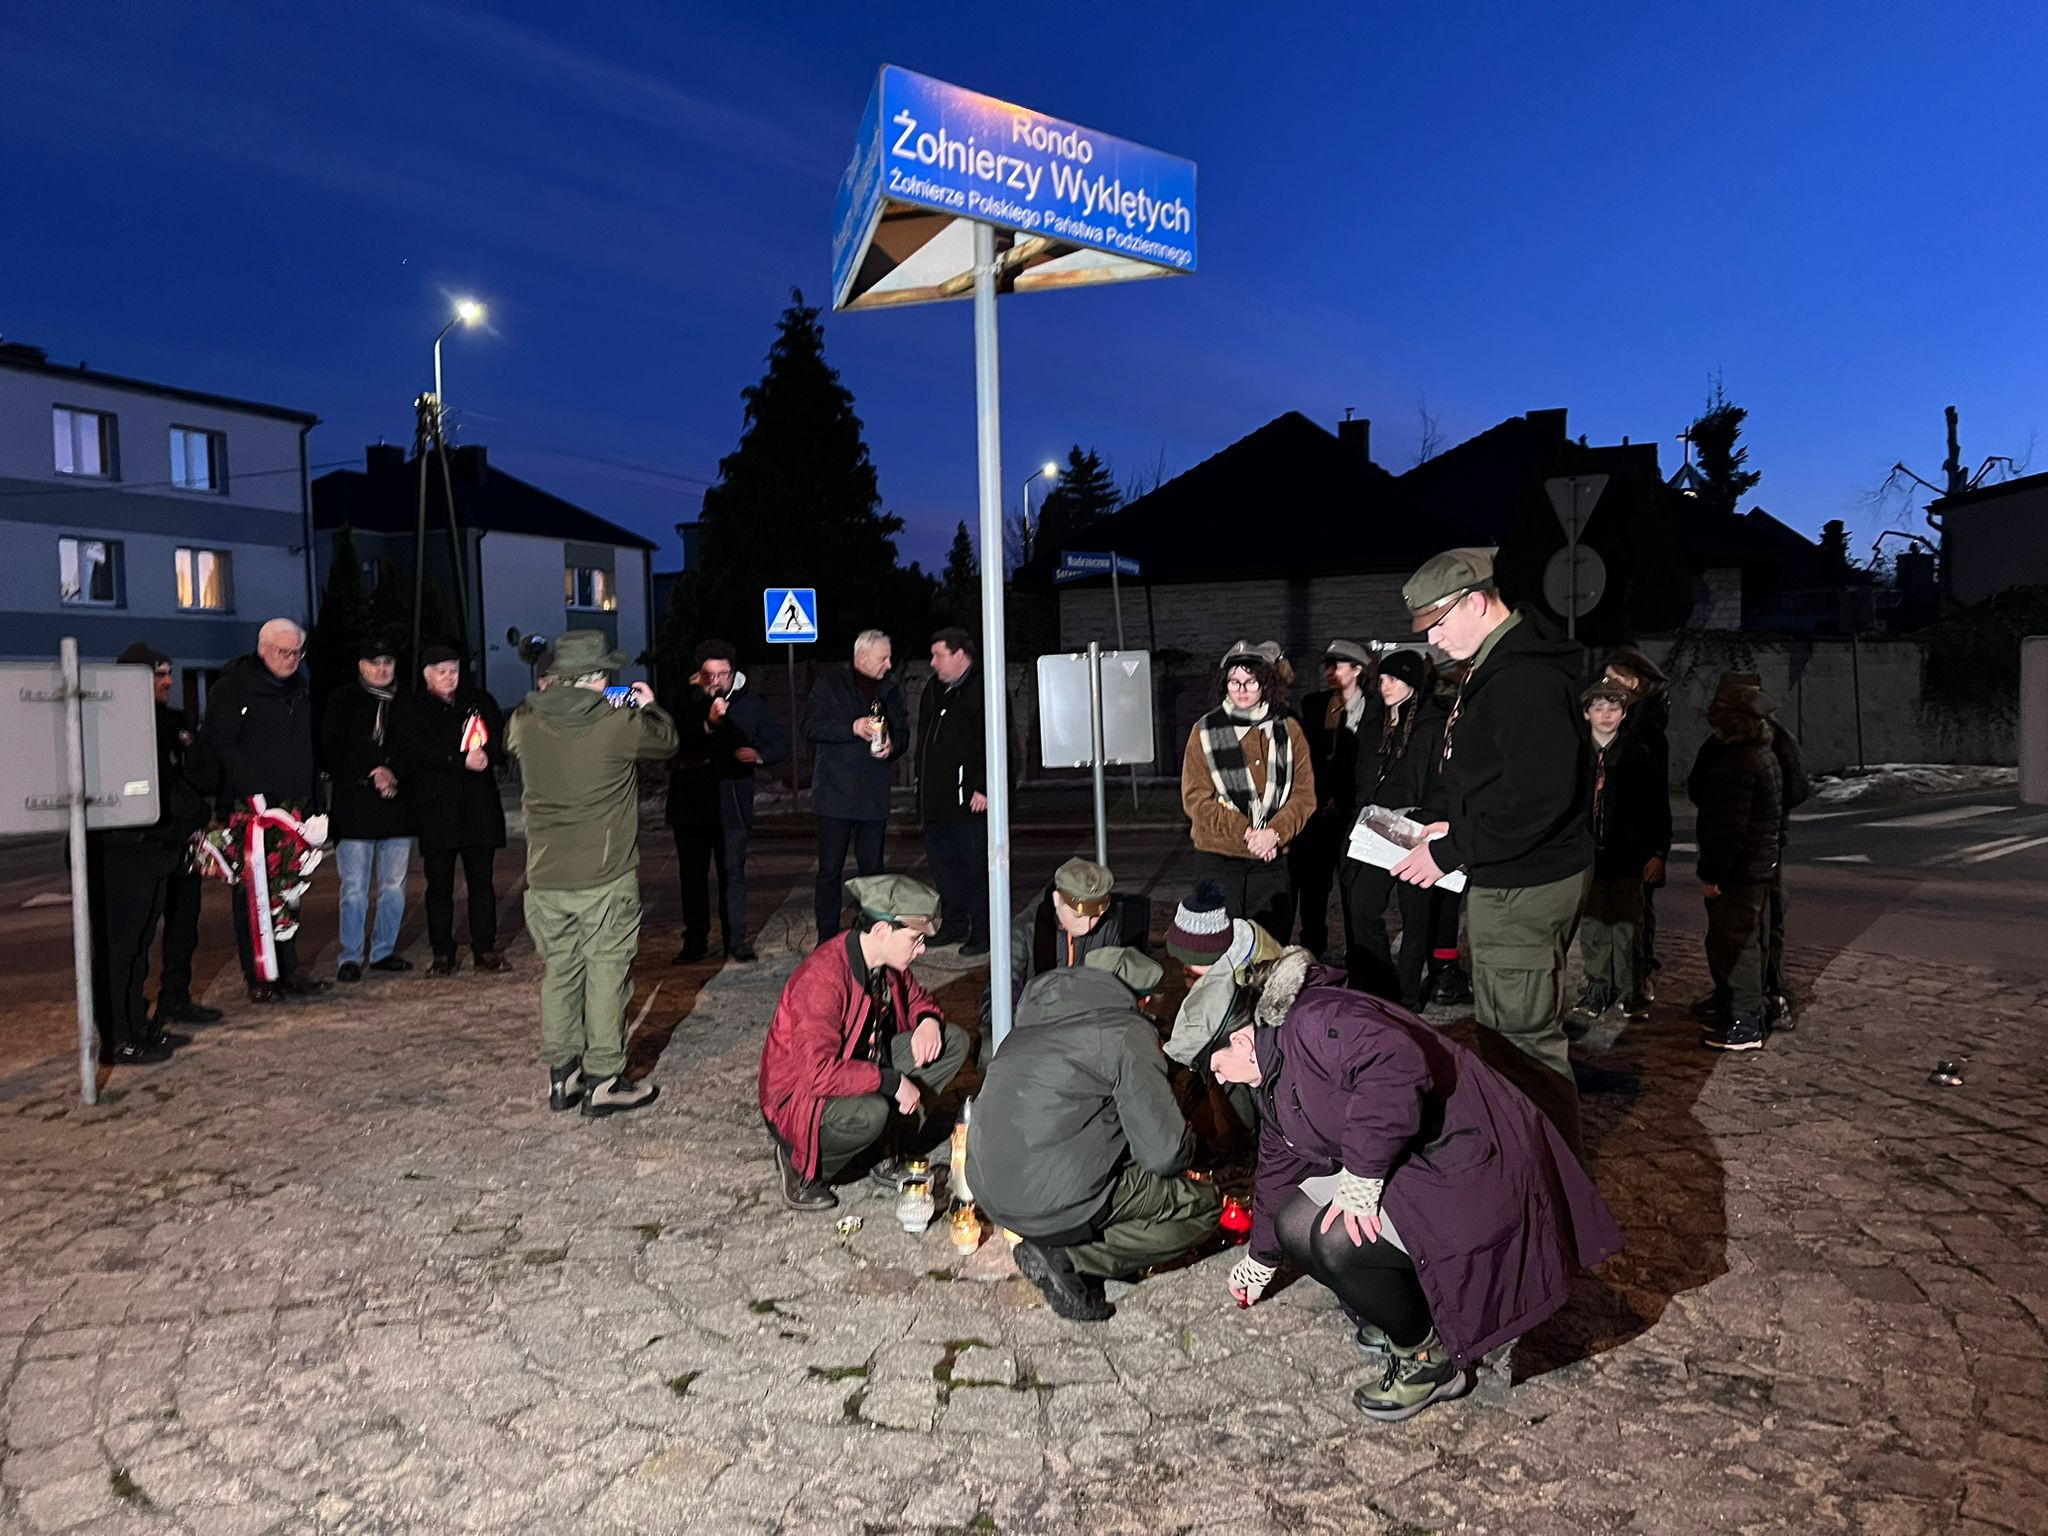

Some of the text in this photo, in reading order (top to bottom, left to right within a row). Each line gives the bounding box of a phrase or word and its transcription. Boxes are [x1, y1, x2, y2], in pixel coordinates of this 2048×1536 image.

[891, 109, 1191, 235] Żołnierzy Wyklętych
[1012, 112, 1093, 165] Rondo
[889, 166, 1192, 267] Żołnierze Polskiego Państwa Podziemnego
